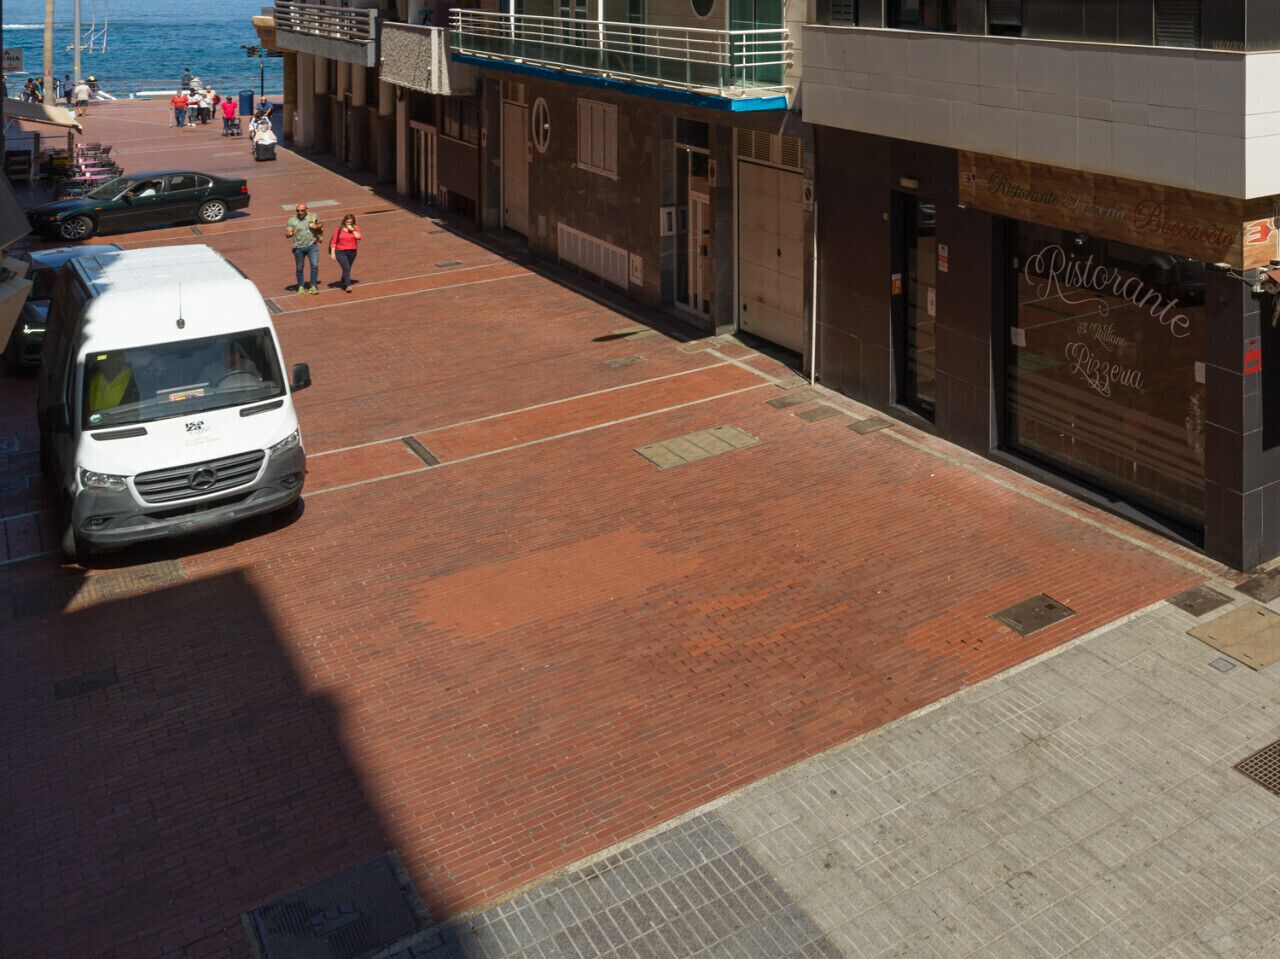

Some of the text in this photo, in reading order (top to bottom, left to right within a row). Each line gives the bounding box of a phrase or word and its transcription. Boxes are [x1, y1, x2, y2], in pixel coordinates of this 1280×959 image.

[988, 170, 1058, 205] Ristorante
[1025, 244, 1190, 338] Ristorante
[1065, 342, 1144, 397] Pizzeria
